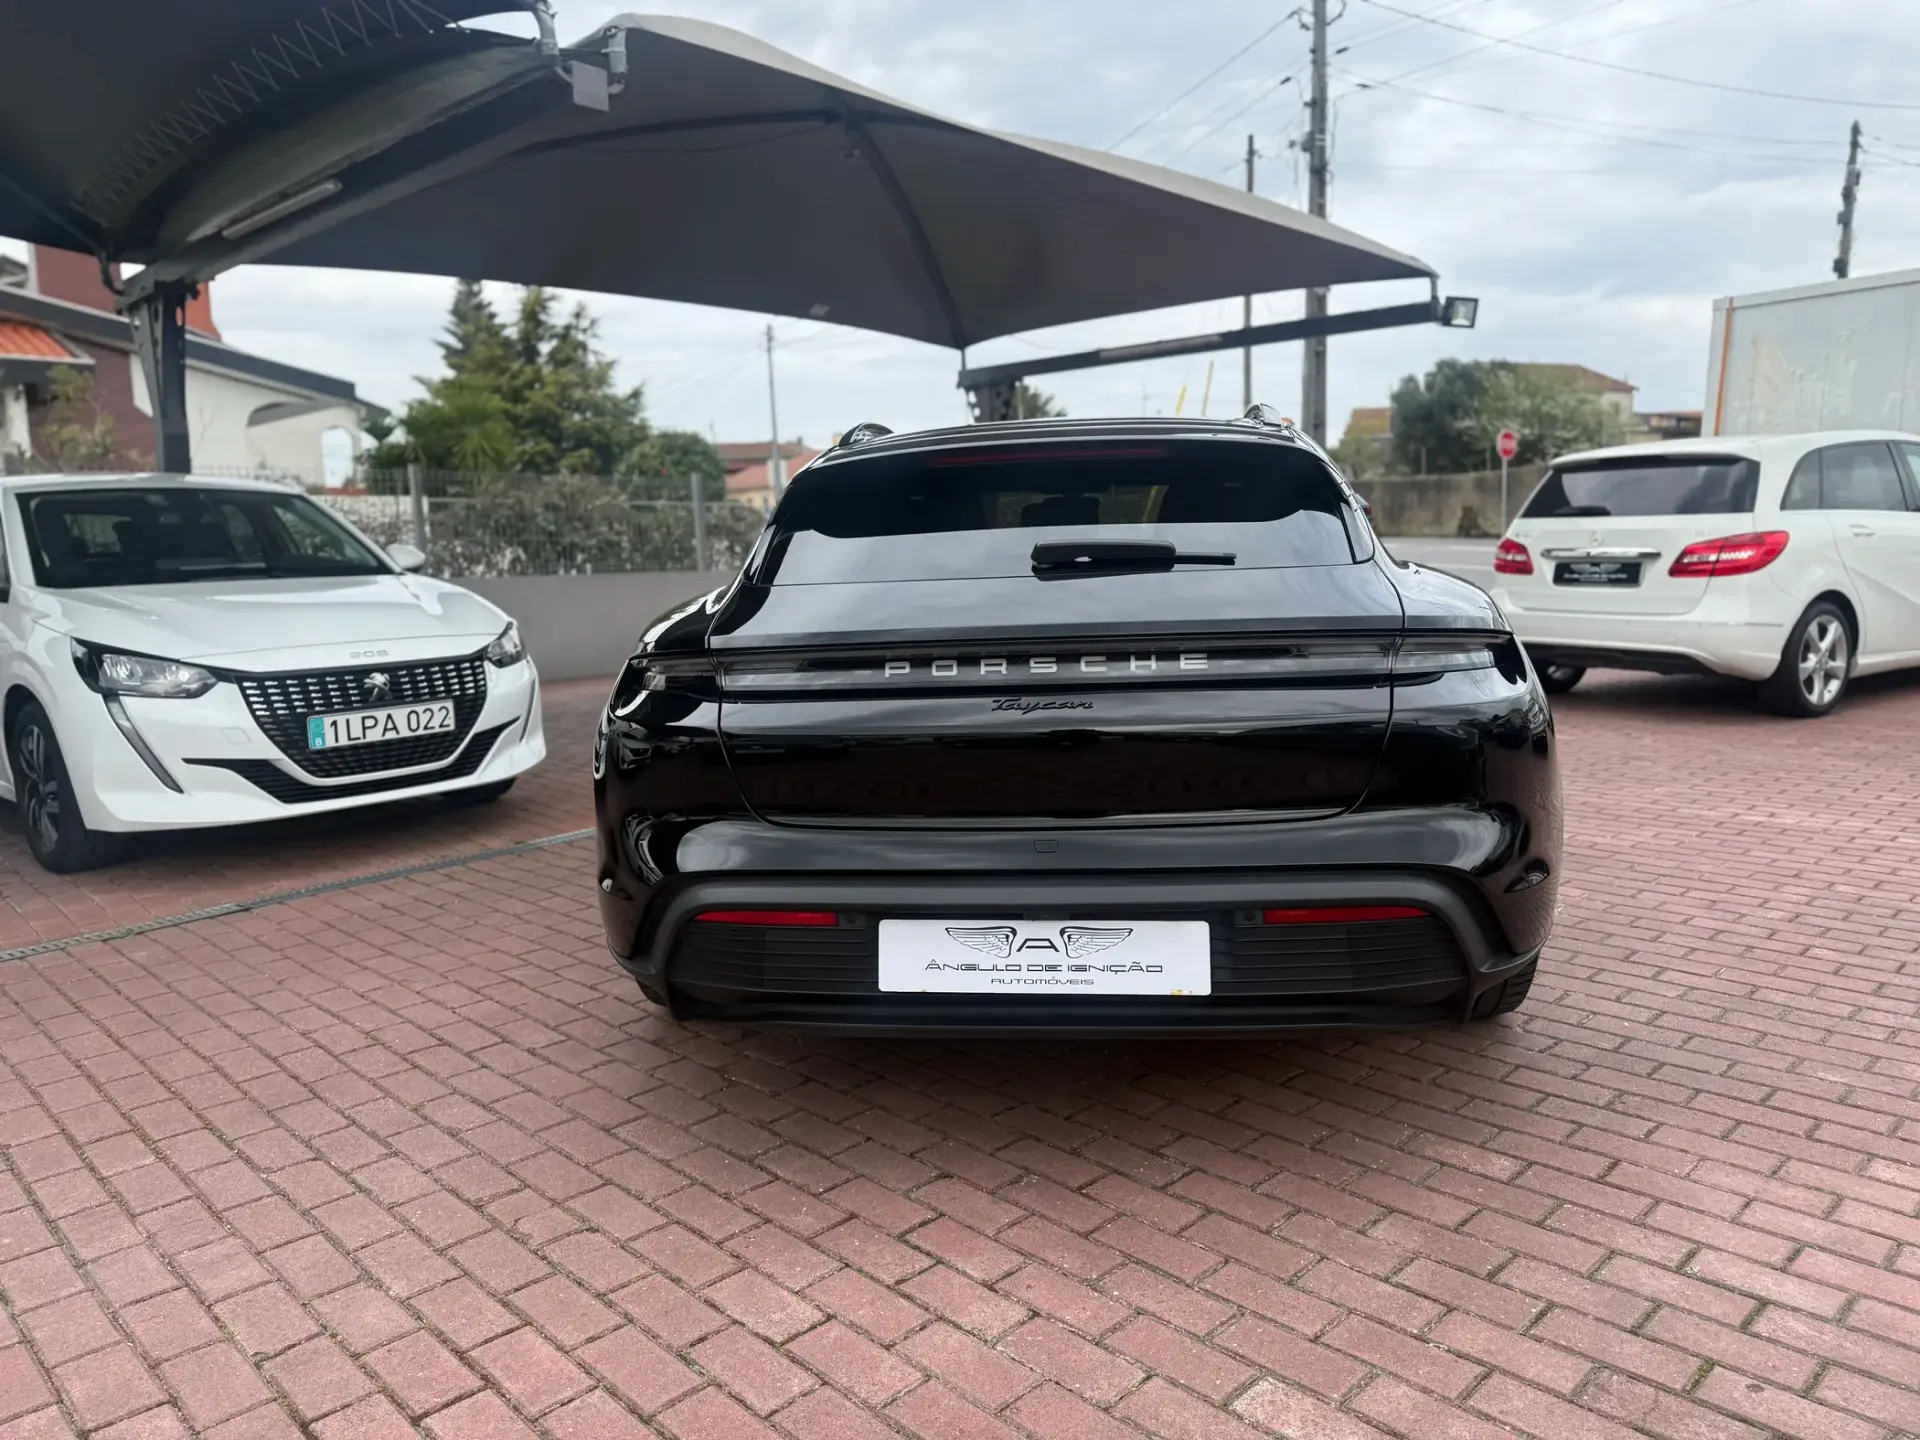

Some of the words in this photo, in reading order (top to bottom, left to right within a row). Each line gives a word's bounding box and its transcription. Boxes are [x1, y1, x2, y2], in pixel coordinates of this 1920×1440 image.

[885, 653, 1208, 677] PORSCHE
[991, 698, 1094, 715] Taycan
[330, 713, 400, 744] 1LPA
[407, 705, 451, 733] 022
[925, 959, 1022, 972] ÂNGULO
[1027, 964, 1063, 972] DE
[1067, 961, 1163, 975] IGNIÇÃO
[991, 976, 1095, 986] AUTOMÓVEIS
